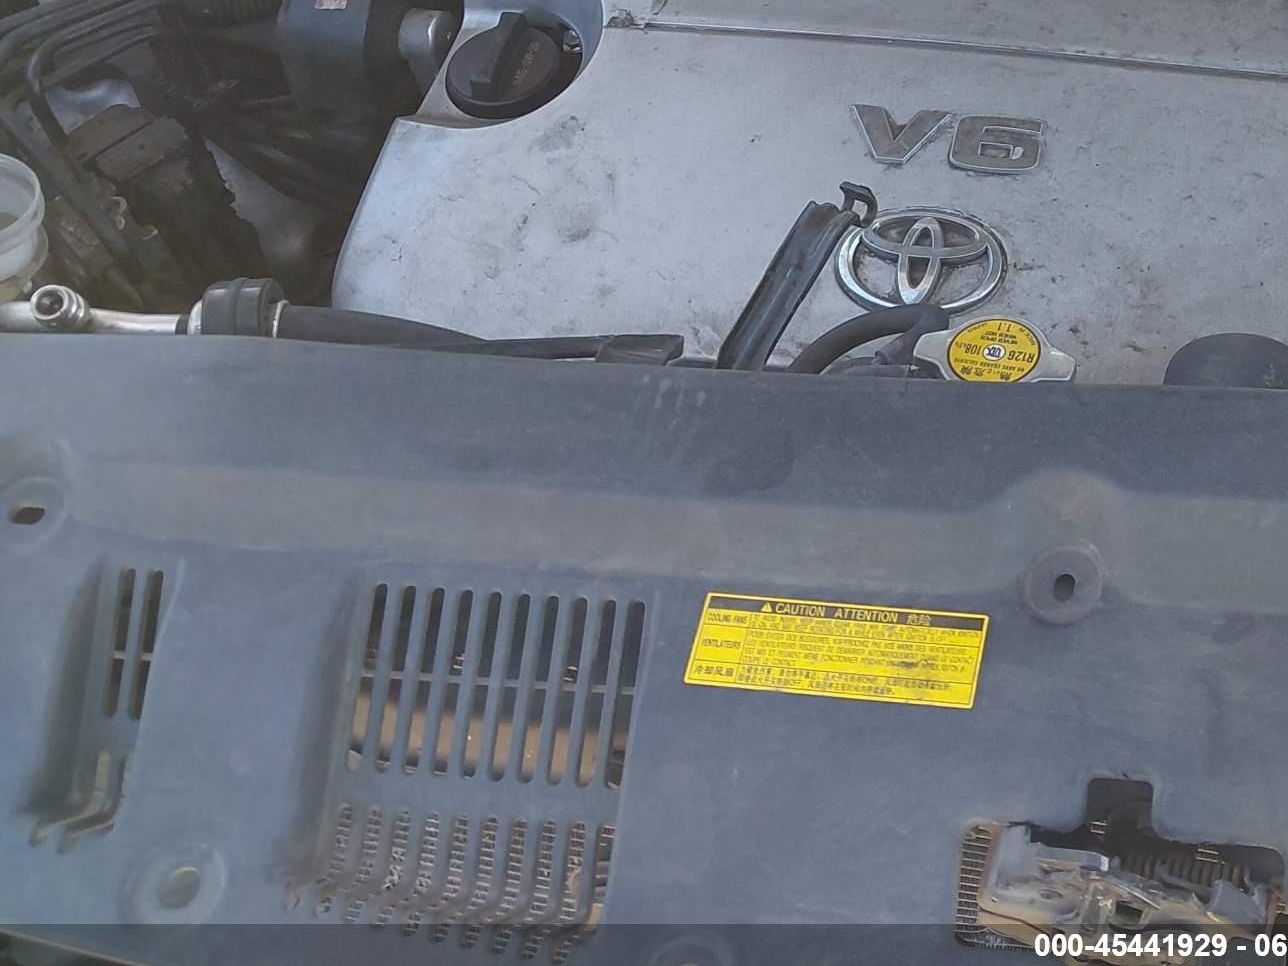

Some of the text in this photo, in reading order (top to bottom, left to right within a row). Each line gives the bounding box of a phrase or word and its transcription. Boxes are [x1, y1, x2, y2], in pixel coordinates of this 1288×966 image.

[851, 104, 1045, 173] V6
[1007, 350, 1035, 363] R126
[775, 603, 826, 616] CAUTION
[833, 607, 898, 624] ATTENTION
